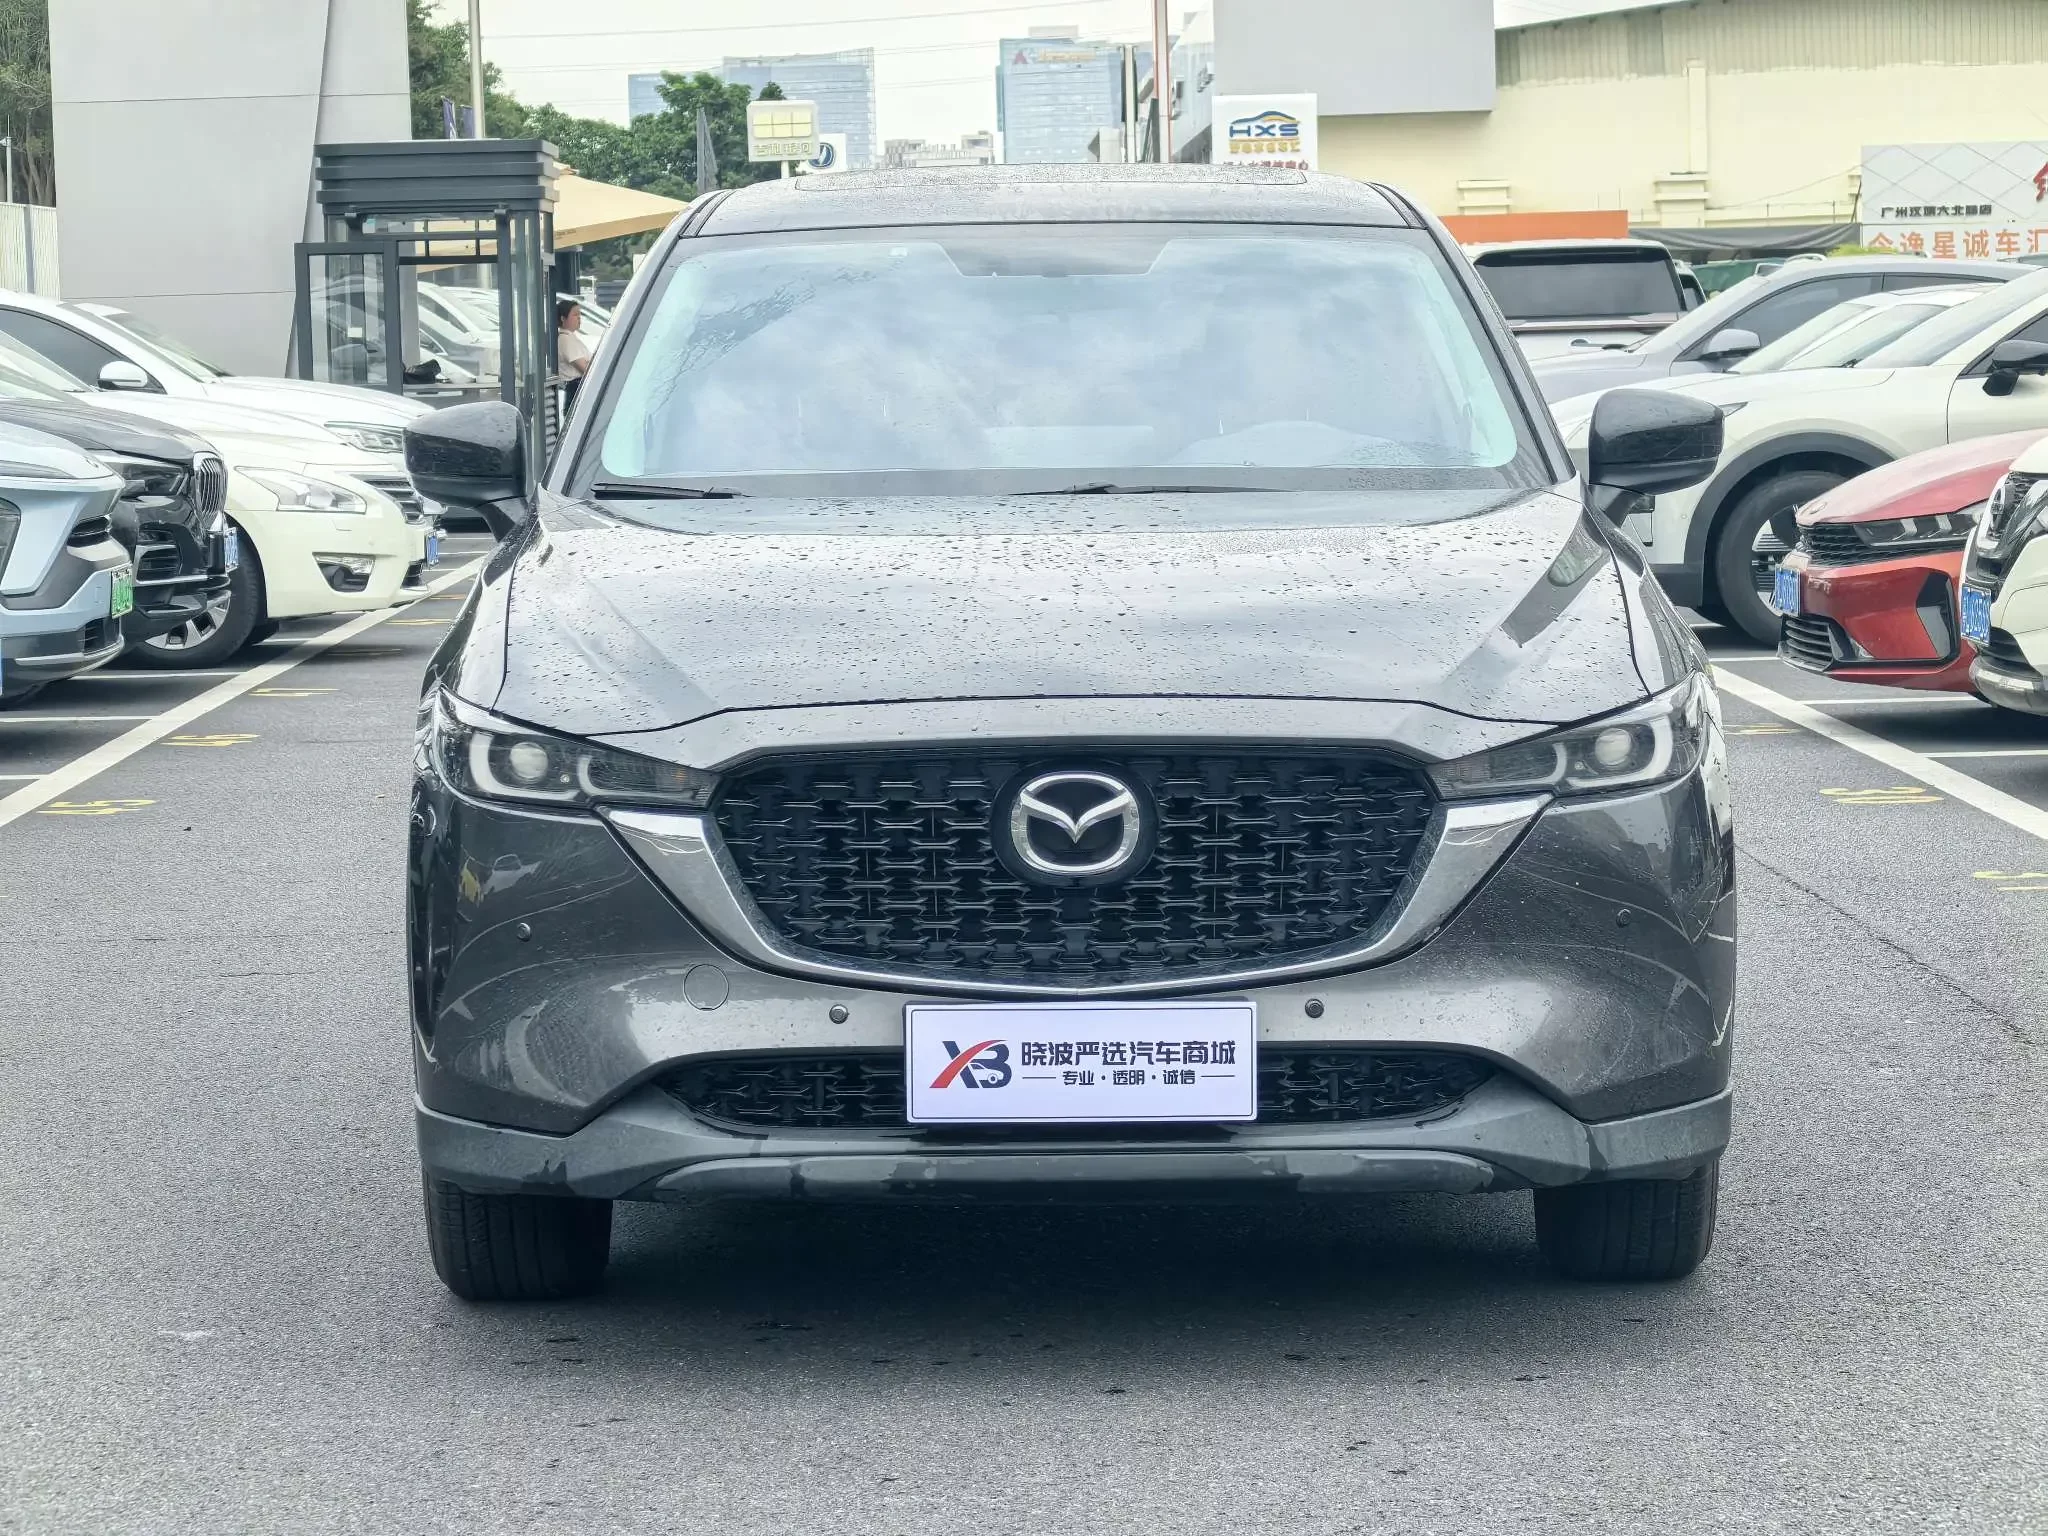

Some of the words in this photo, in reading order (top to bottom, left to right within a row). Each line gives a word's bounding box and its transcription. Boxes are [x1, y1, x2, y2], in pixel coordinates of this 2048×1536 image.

[1229, 123, 1299, 138] HXS
[1021, 1040, 1236, 1066] 晓波严选汽车商城
